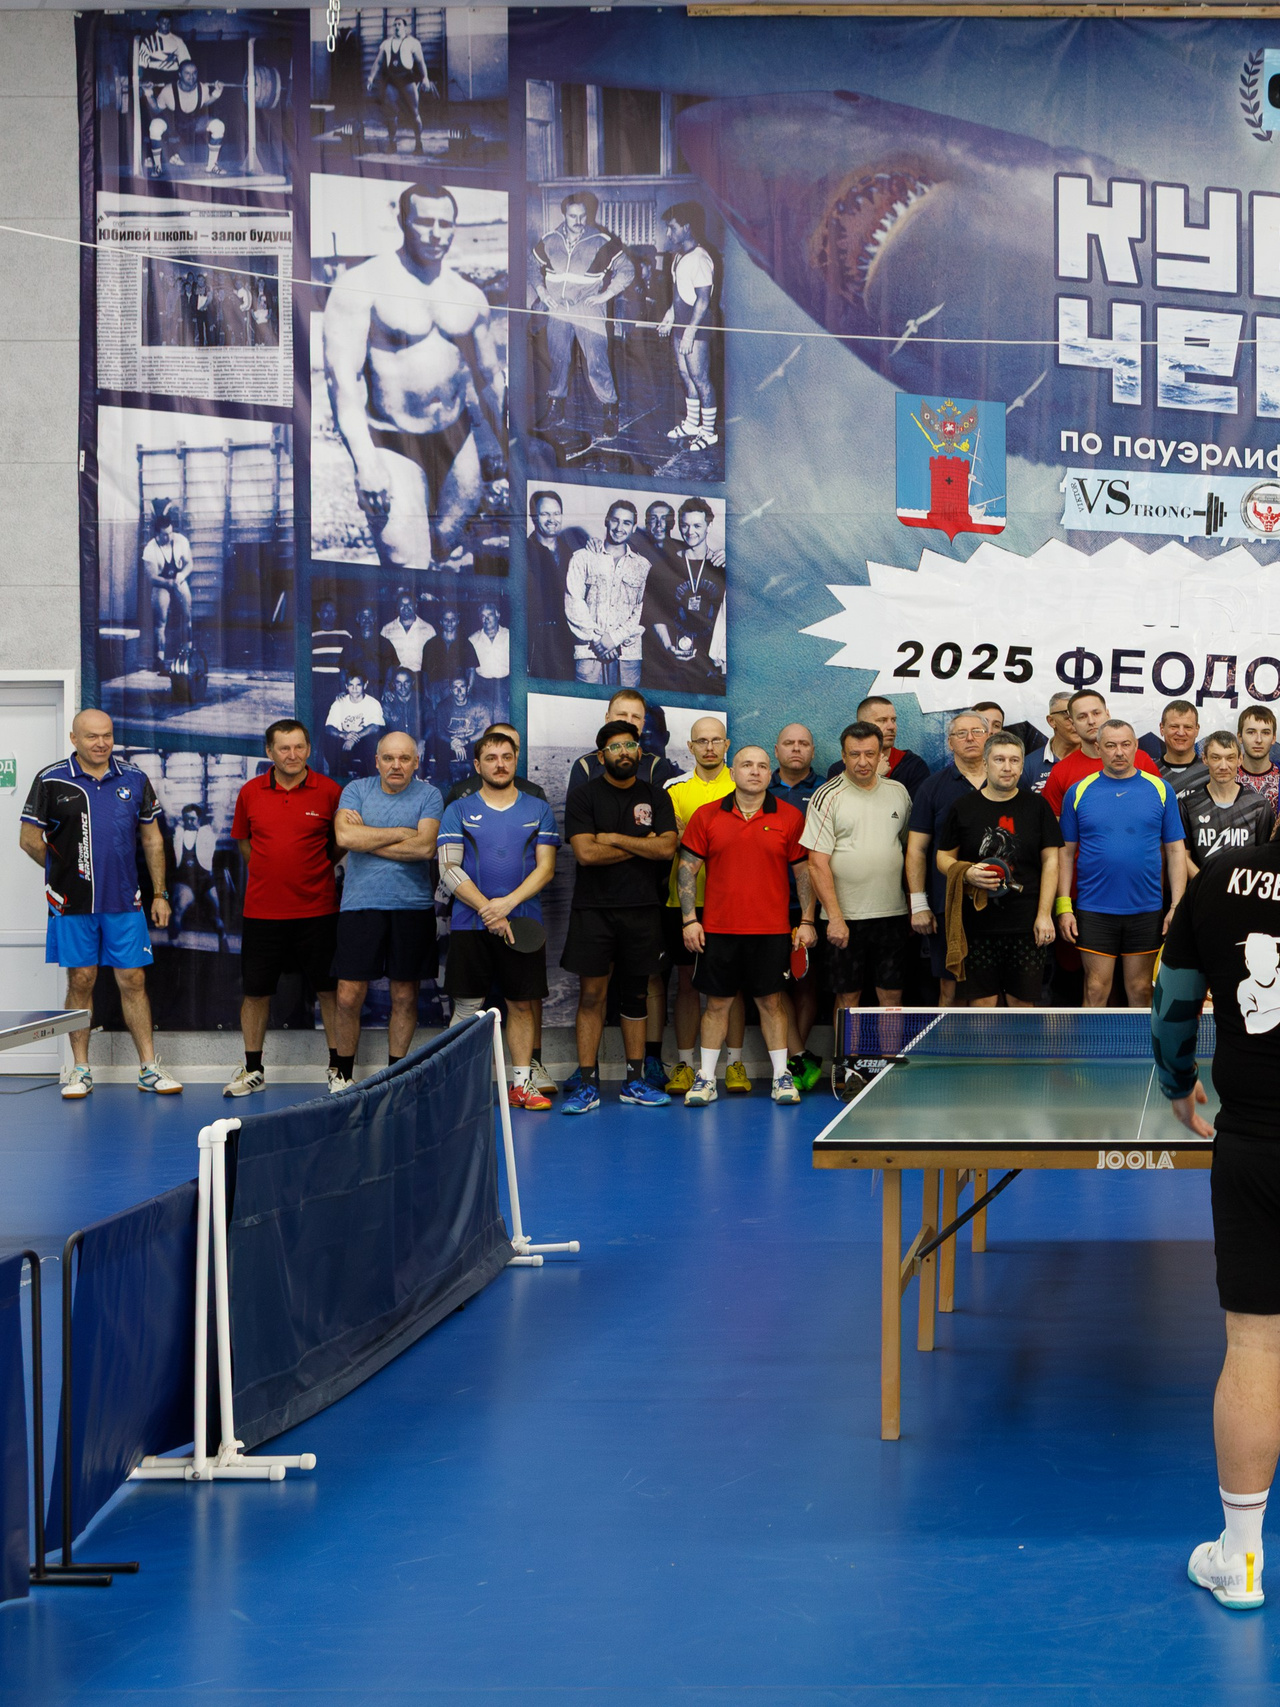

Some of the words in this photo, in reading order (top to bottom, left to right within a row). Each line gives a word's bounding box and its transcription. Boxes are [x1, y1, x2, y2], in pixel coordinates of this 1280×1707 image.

[98, 227, 150, 242] Юбилей
[153, 230, 198, 242] школы
[211, 230, 246, 242] залог
[1060, 430, 1103, 456] по
[893, 640, 1034, 684] 2025
[1097, 1151, 1174, 1170] JOOLA
